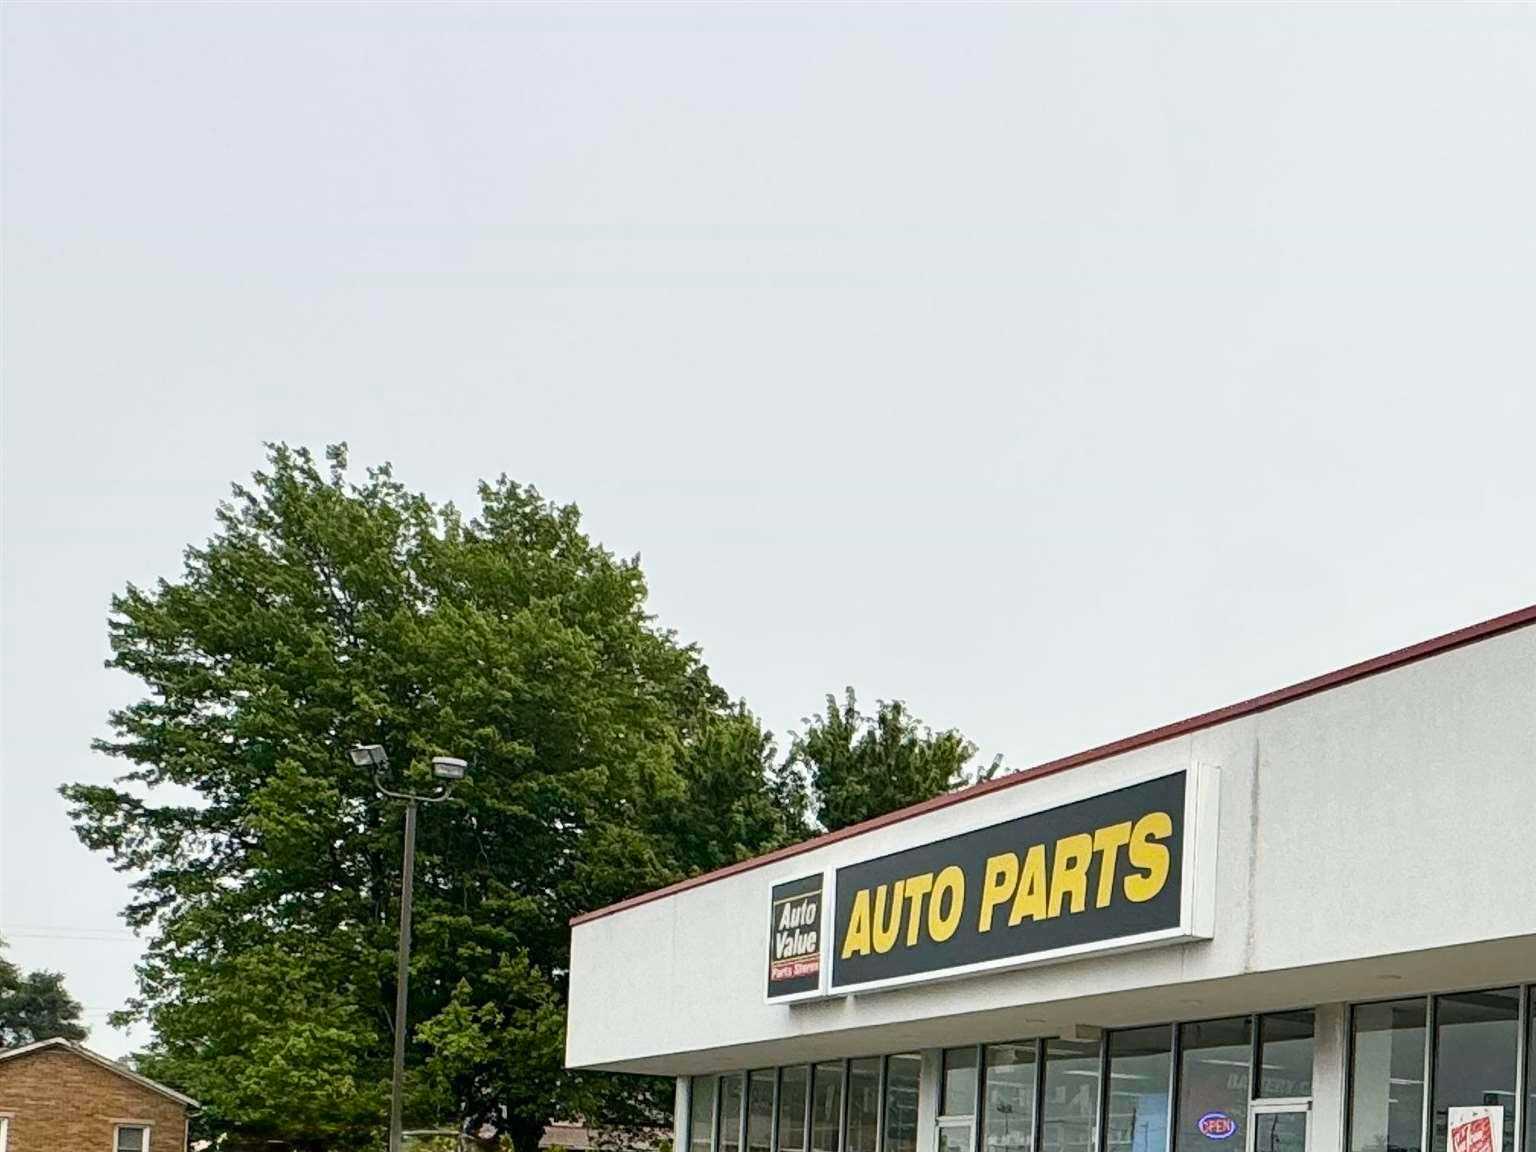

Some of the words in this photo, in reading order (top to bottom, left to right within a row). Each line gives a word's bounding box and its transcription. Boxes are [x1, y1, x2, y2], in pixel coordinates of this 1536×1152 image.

[841, 865, 965, 960] AUTO
[978, 811, 1172, 933] PARTS
[778, 899, 816, 931] Auto
[776, 928, 817, 959] Value
